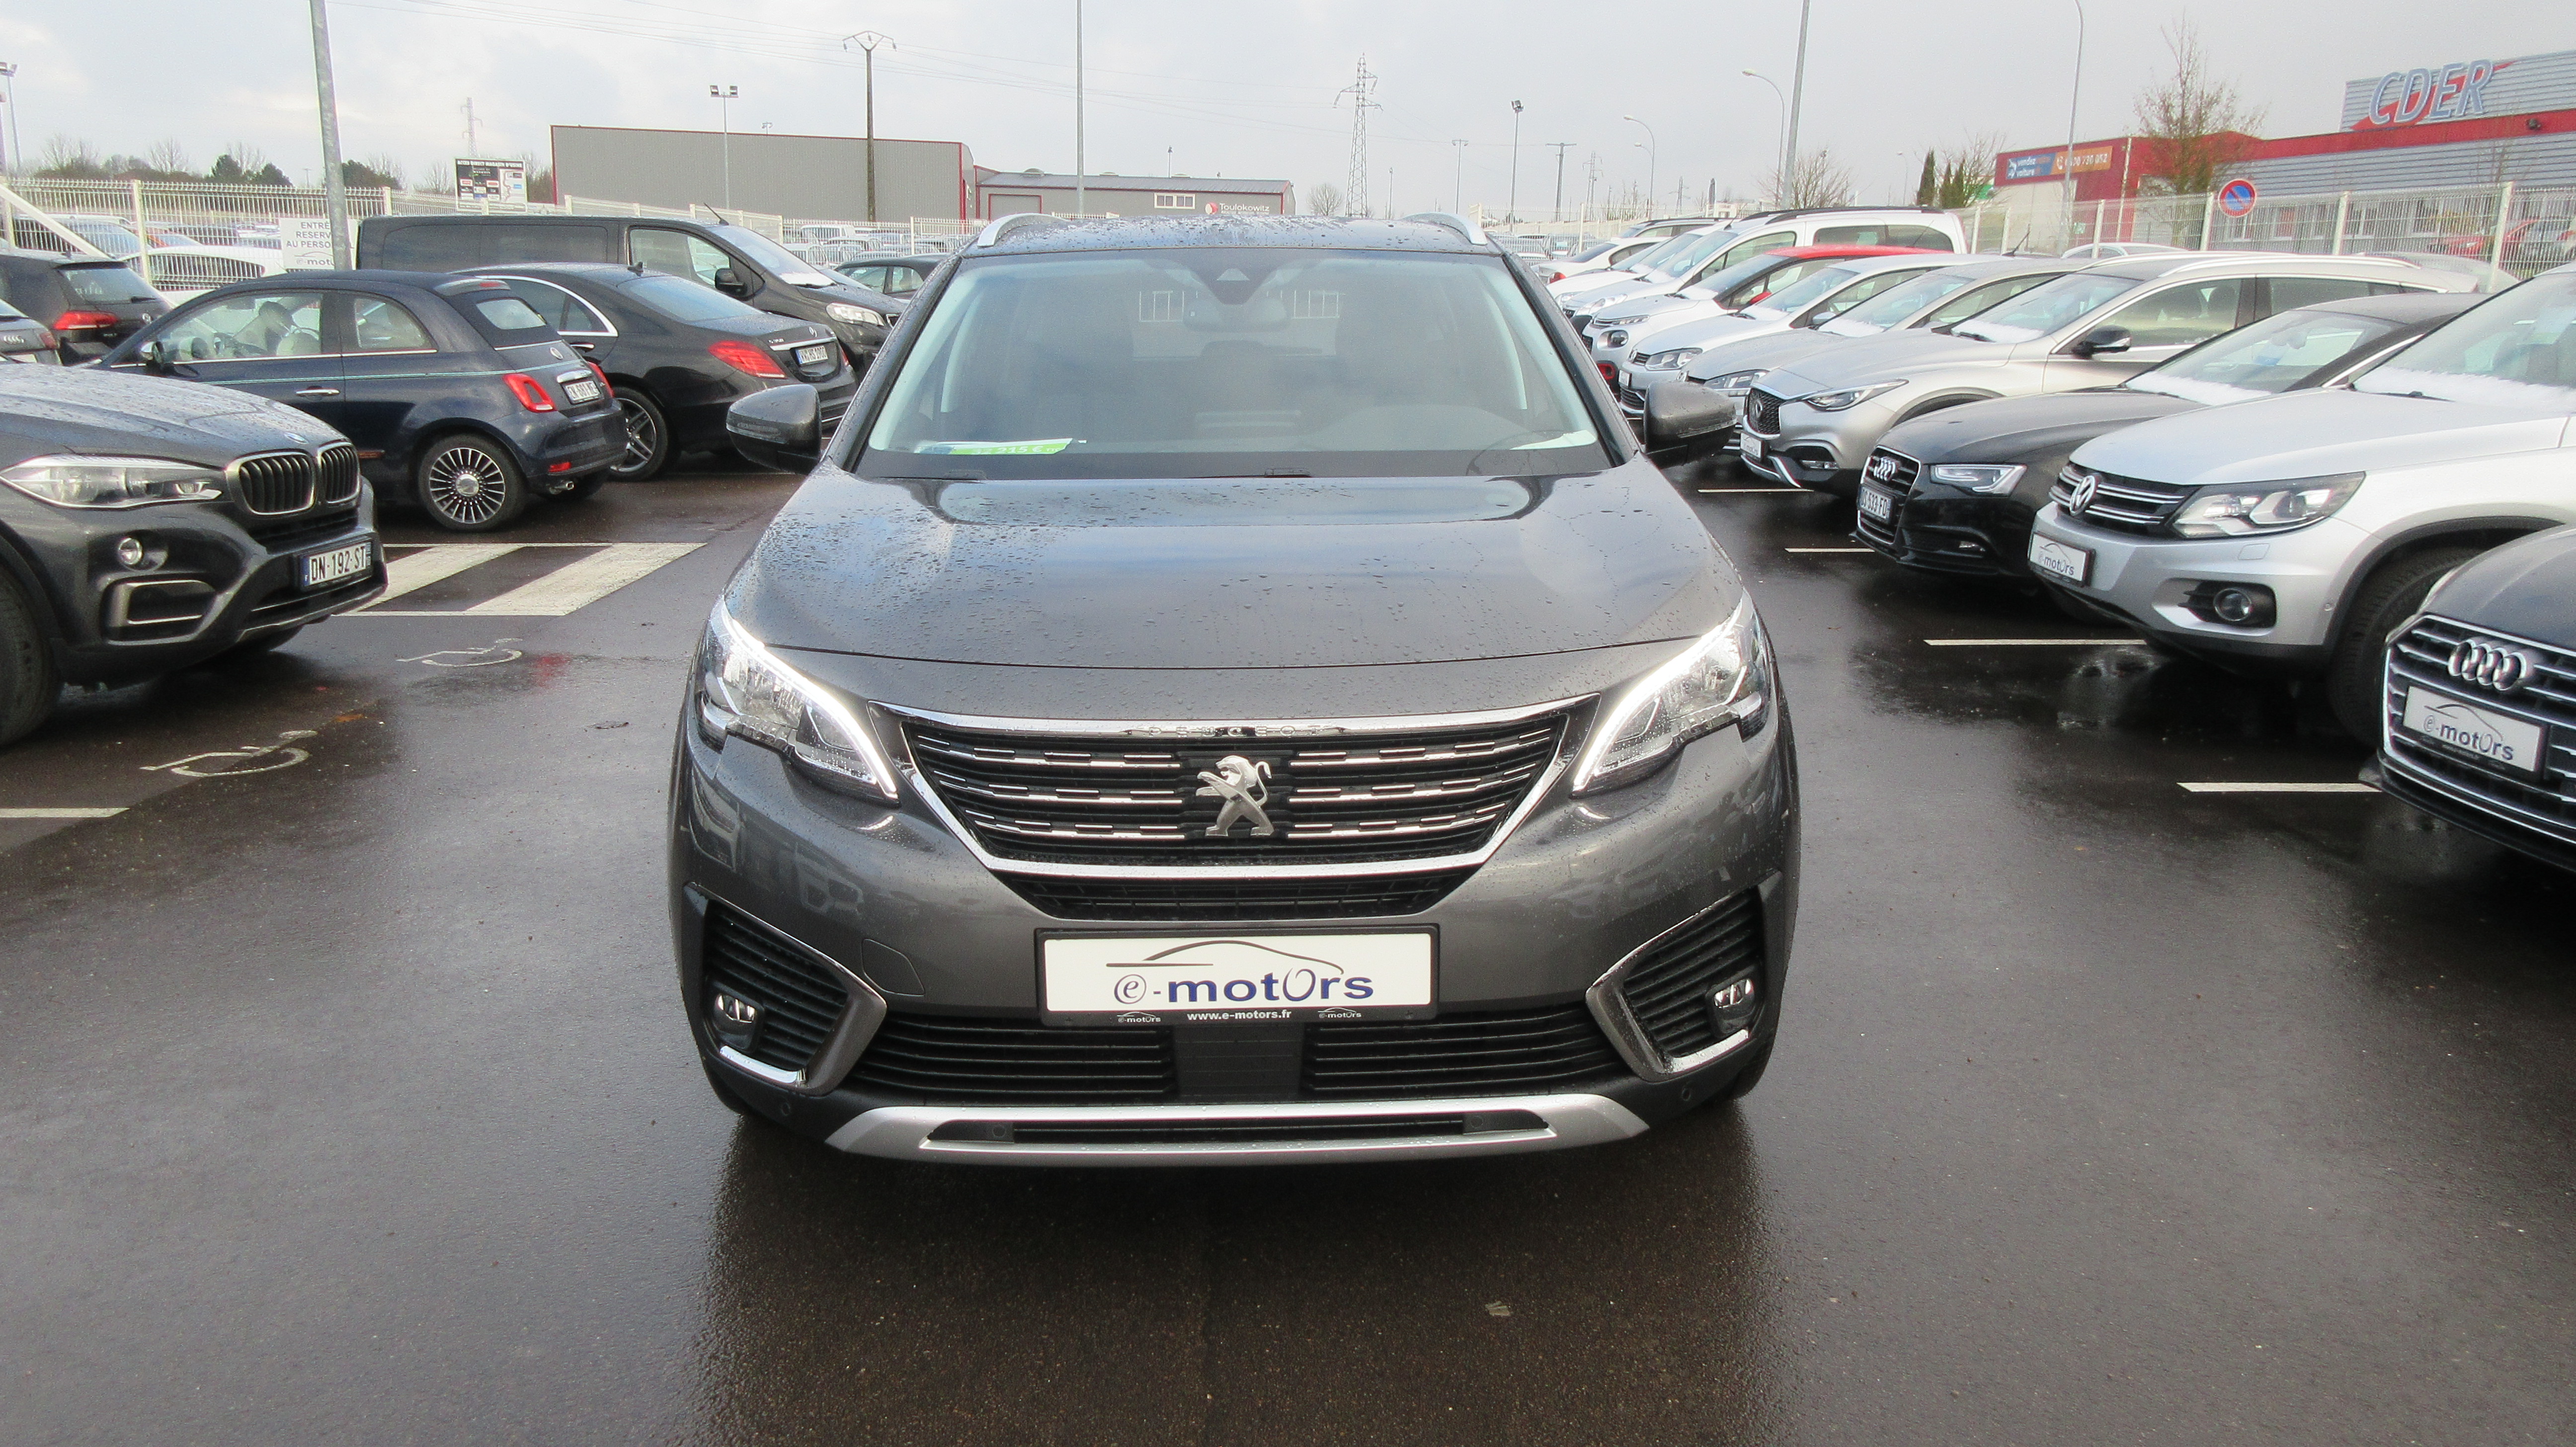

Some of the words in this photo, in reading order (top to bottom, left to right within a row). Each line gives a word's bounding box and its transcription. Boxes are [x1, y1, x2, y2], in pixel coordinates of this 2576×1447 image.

[2369, 59, 2494, 124] CDER
[1219, 203, 1270, 212] Toulokowitz
[301, 221, 330, 230] ENTRÉ
[1187, 1009, 1292, 1020] www.e-motors.fr
